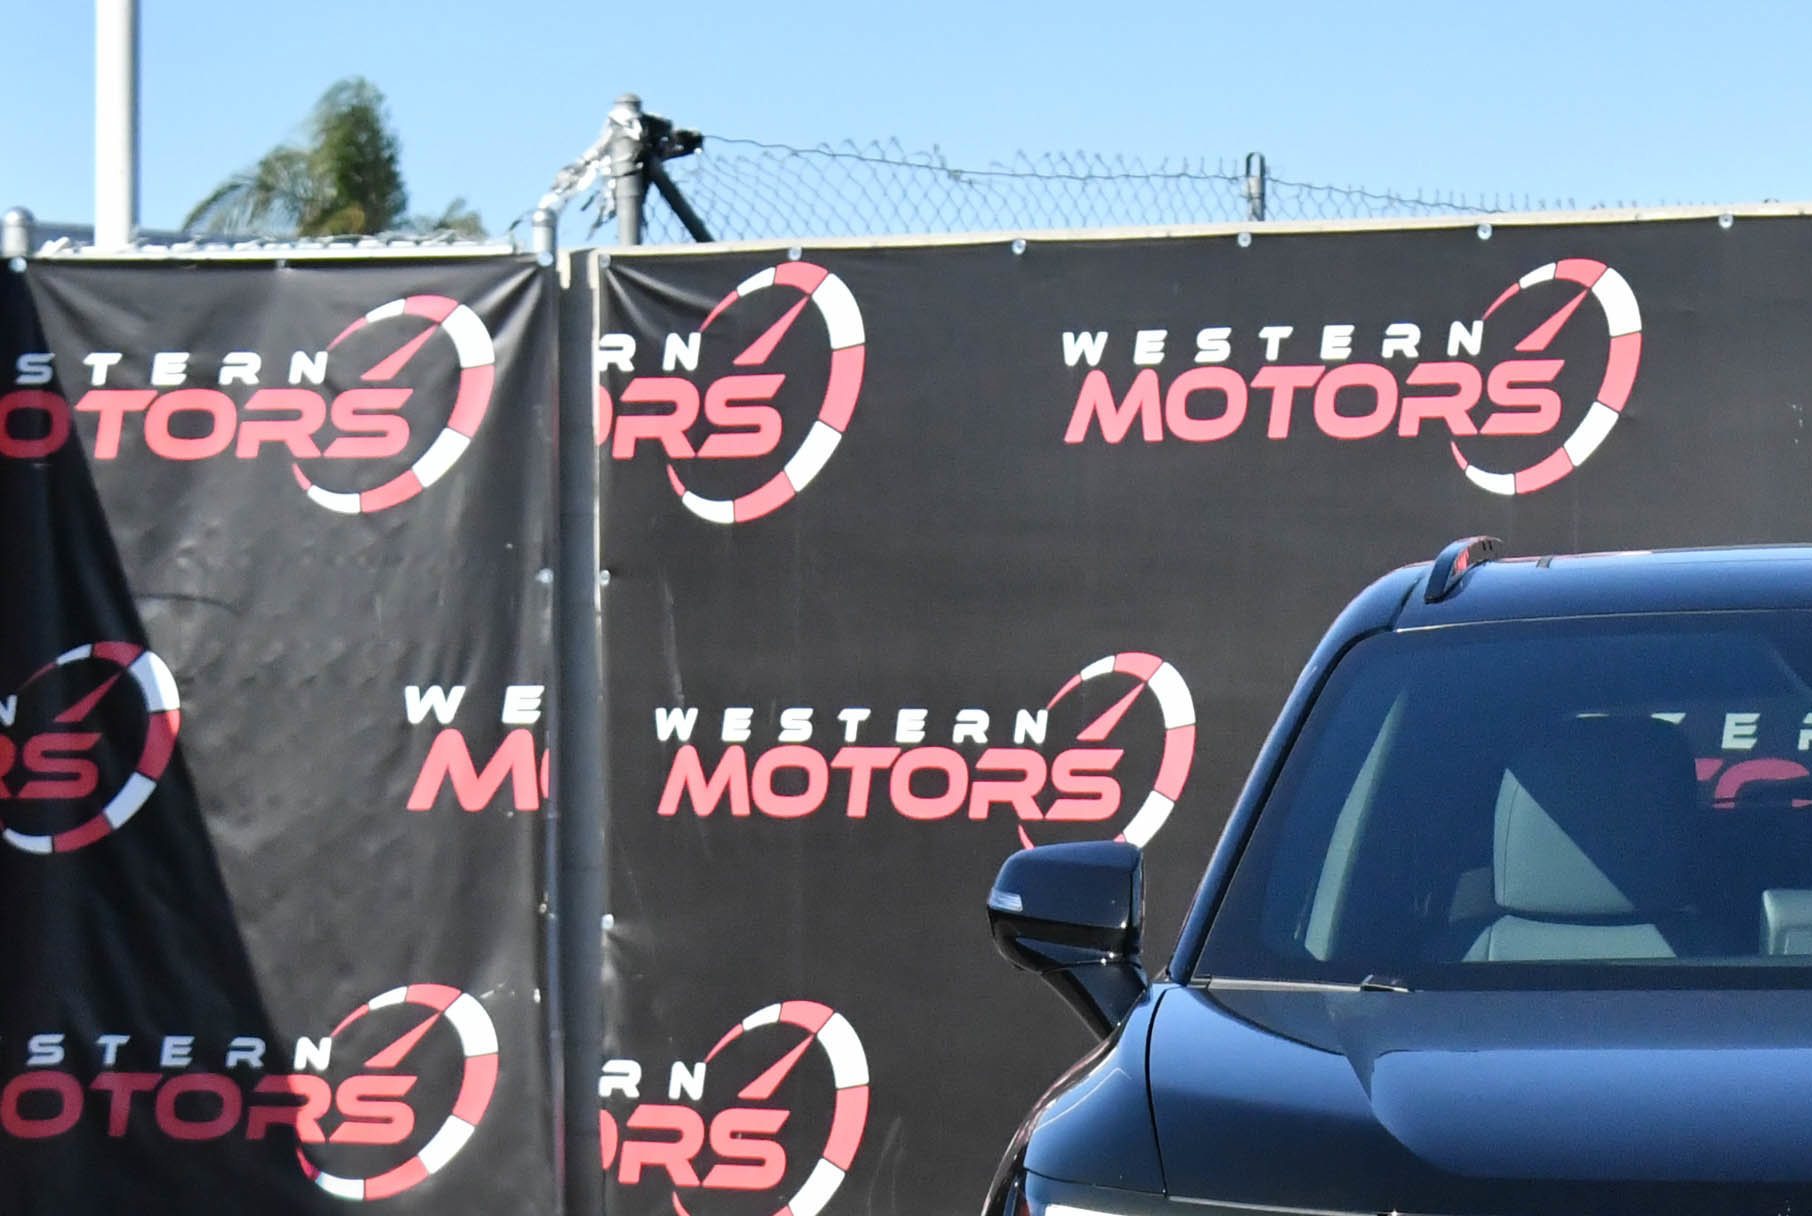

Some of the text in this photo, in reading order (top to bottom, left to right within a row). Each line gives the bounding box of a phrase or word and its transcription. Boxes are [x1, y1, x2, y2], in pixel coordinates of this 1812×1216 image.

[15, 351, 329, 386] STERN
[598, 332, 701, 372] RN
[1061, 320, 1484, 367] WESTERN
[0, 387, 413, 461] OTORS
[597, 374, 786, 459] RS
[1063, 359, 1565, 445] MOTORS
[404, 684, 546, 725] WE
[654, 706, 1050, 746] WESTERN
[405, 728, 550, 813] M
[655, 745, 1125, 822] MOTORS
[26, 1033, 332, 1071] STERN
[598, 1059, 706, 1101] RN
[0, 1070, 418, 1146] OTORS
[598, 1104, 791, 1192] RS
